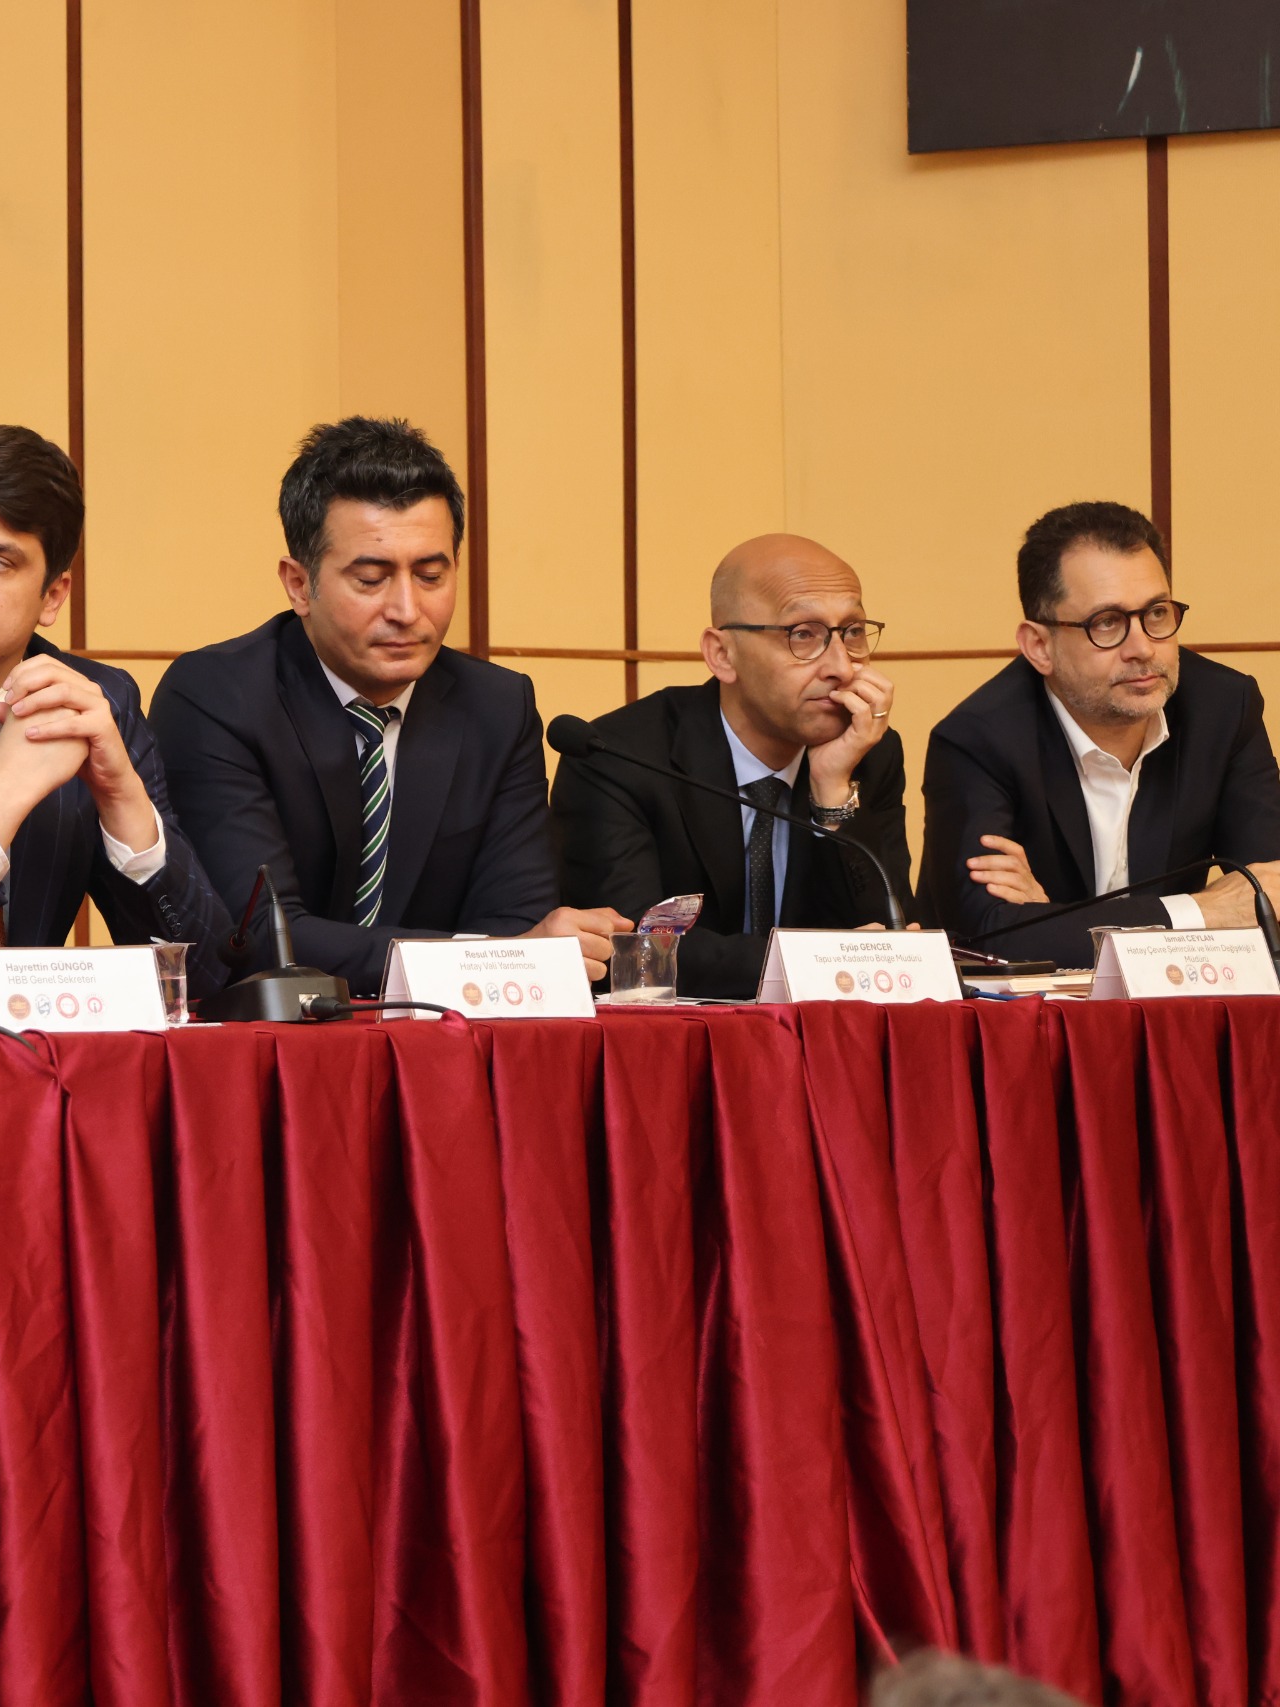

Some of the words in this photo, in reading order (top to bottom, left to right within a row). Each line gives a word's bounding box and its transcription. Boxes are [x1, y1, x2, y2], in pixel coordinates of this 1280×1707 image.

[860, 942, 893, 951] GENCER
[464, 950, 488, 959] Resul
[488, 949, 525, 958] YILDIRIM
[814, 954, 832, 964] Tapu
[842, 954, 875, 962] Kadastro
[5, 962, 49, 973] Hayrettin
[50, 960, 94, 971] GÜNGÖR
[460, 962, 482, 972] Hatay
[8, 975, 28, 984] HBB
[29, 975, 56, 984] Genel
[57, 974, 96, 984] Sekreteri
